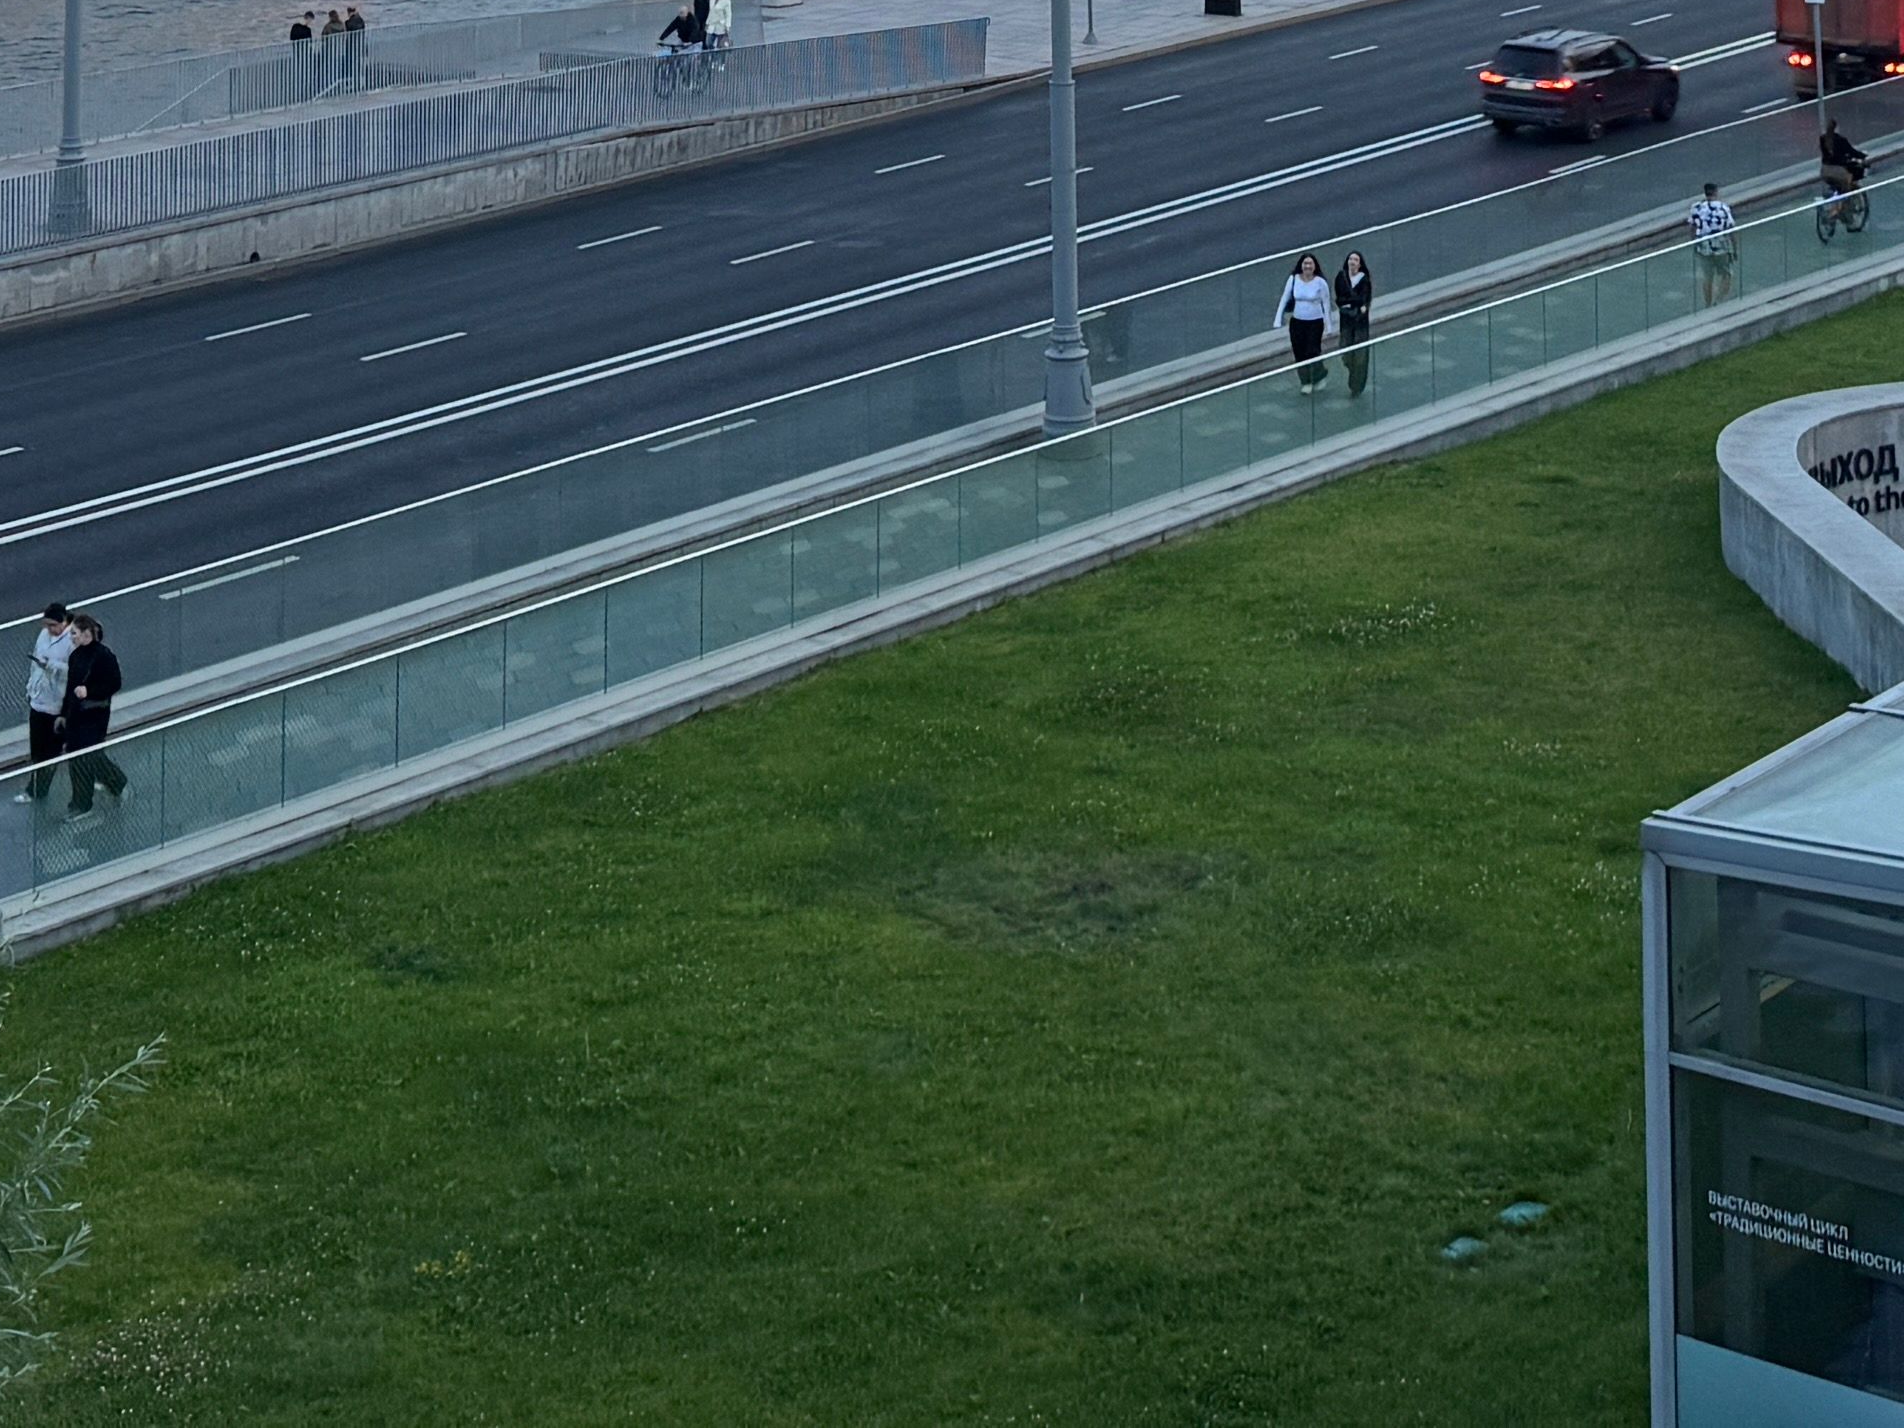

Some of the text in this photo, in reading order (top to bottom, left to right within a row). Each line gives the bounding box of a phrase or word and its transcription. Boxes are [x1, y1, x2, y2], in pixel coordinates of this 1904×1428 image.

[1707, 1189, 1849, 1241] ВЫСТАВОЧНЫЙ ЦИКЛ
[1708, 1210, 1824, 1255] «ТРАДИЦИОННЫЕ
